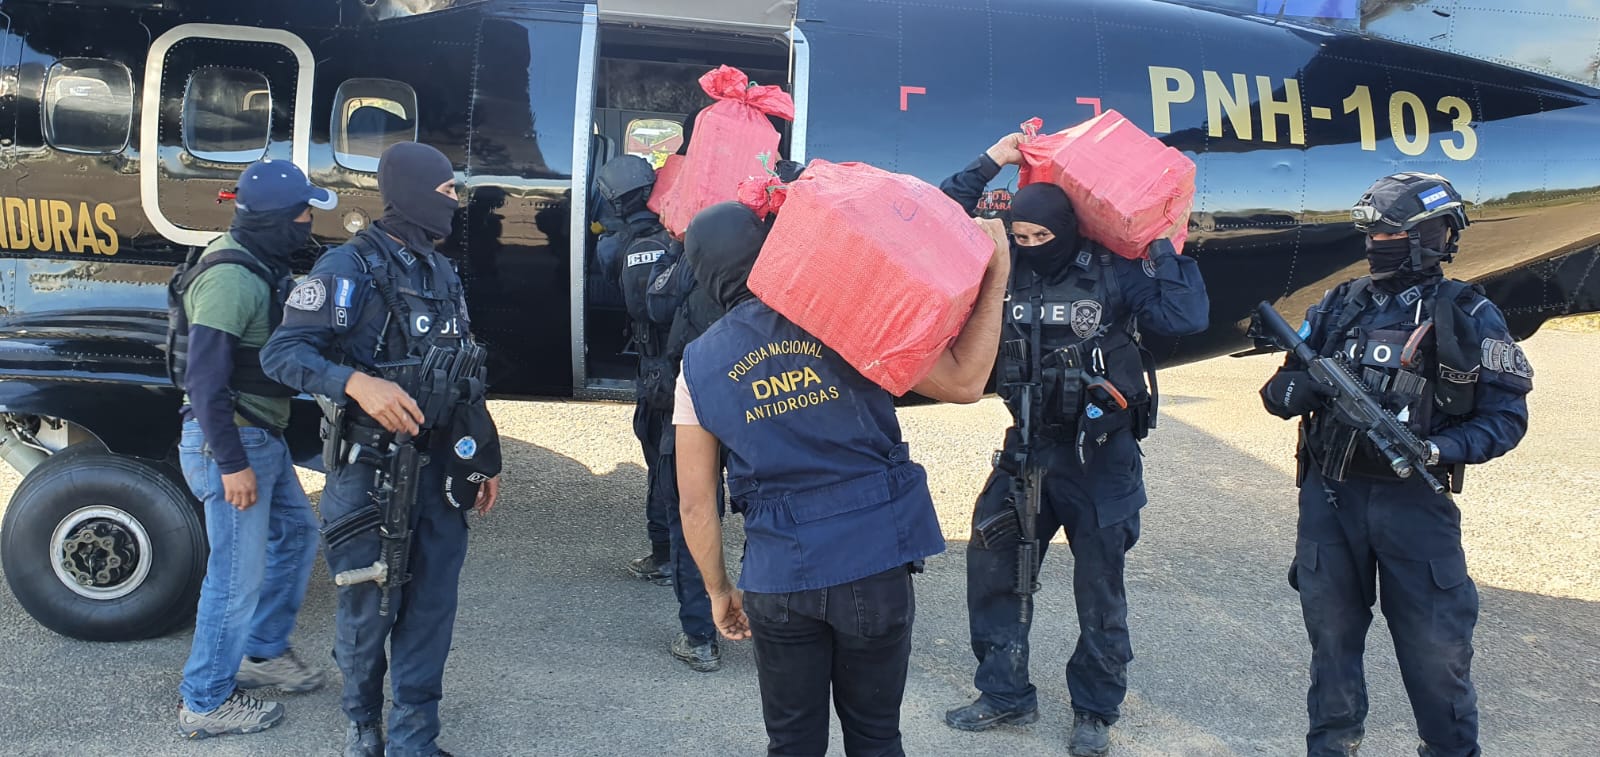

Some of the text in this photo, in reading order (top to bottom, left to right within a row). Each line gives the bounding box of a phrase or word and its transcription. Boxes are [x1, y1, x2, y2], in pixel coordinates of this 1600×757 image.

[1148, 65, 1478, 161] PNH-103
[1013, 305, 1065, 321] CE
[728, 340, 823, 382] POLICIA NACIONAL
[752, 366, 822, 400] DNPA
[745, 386, 840, 424] ANTIDROGAS
